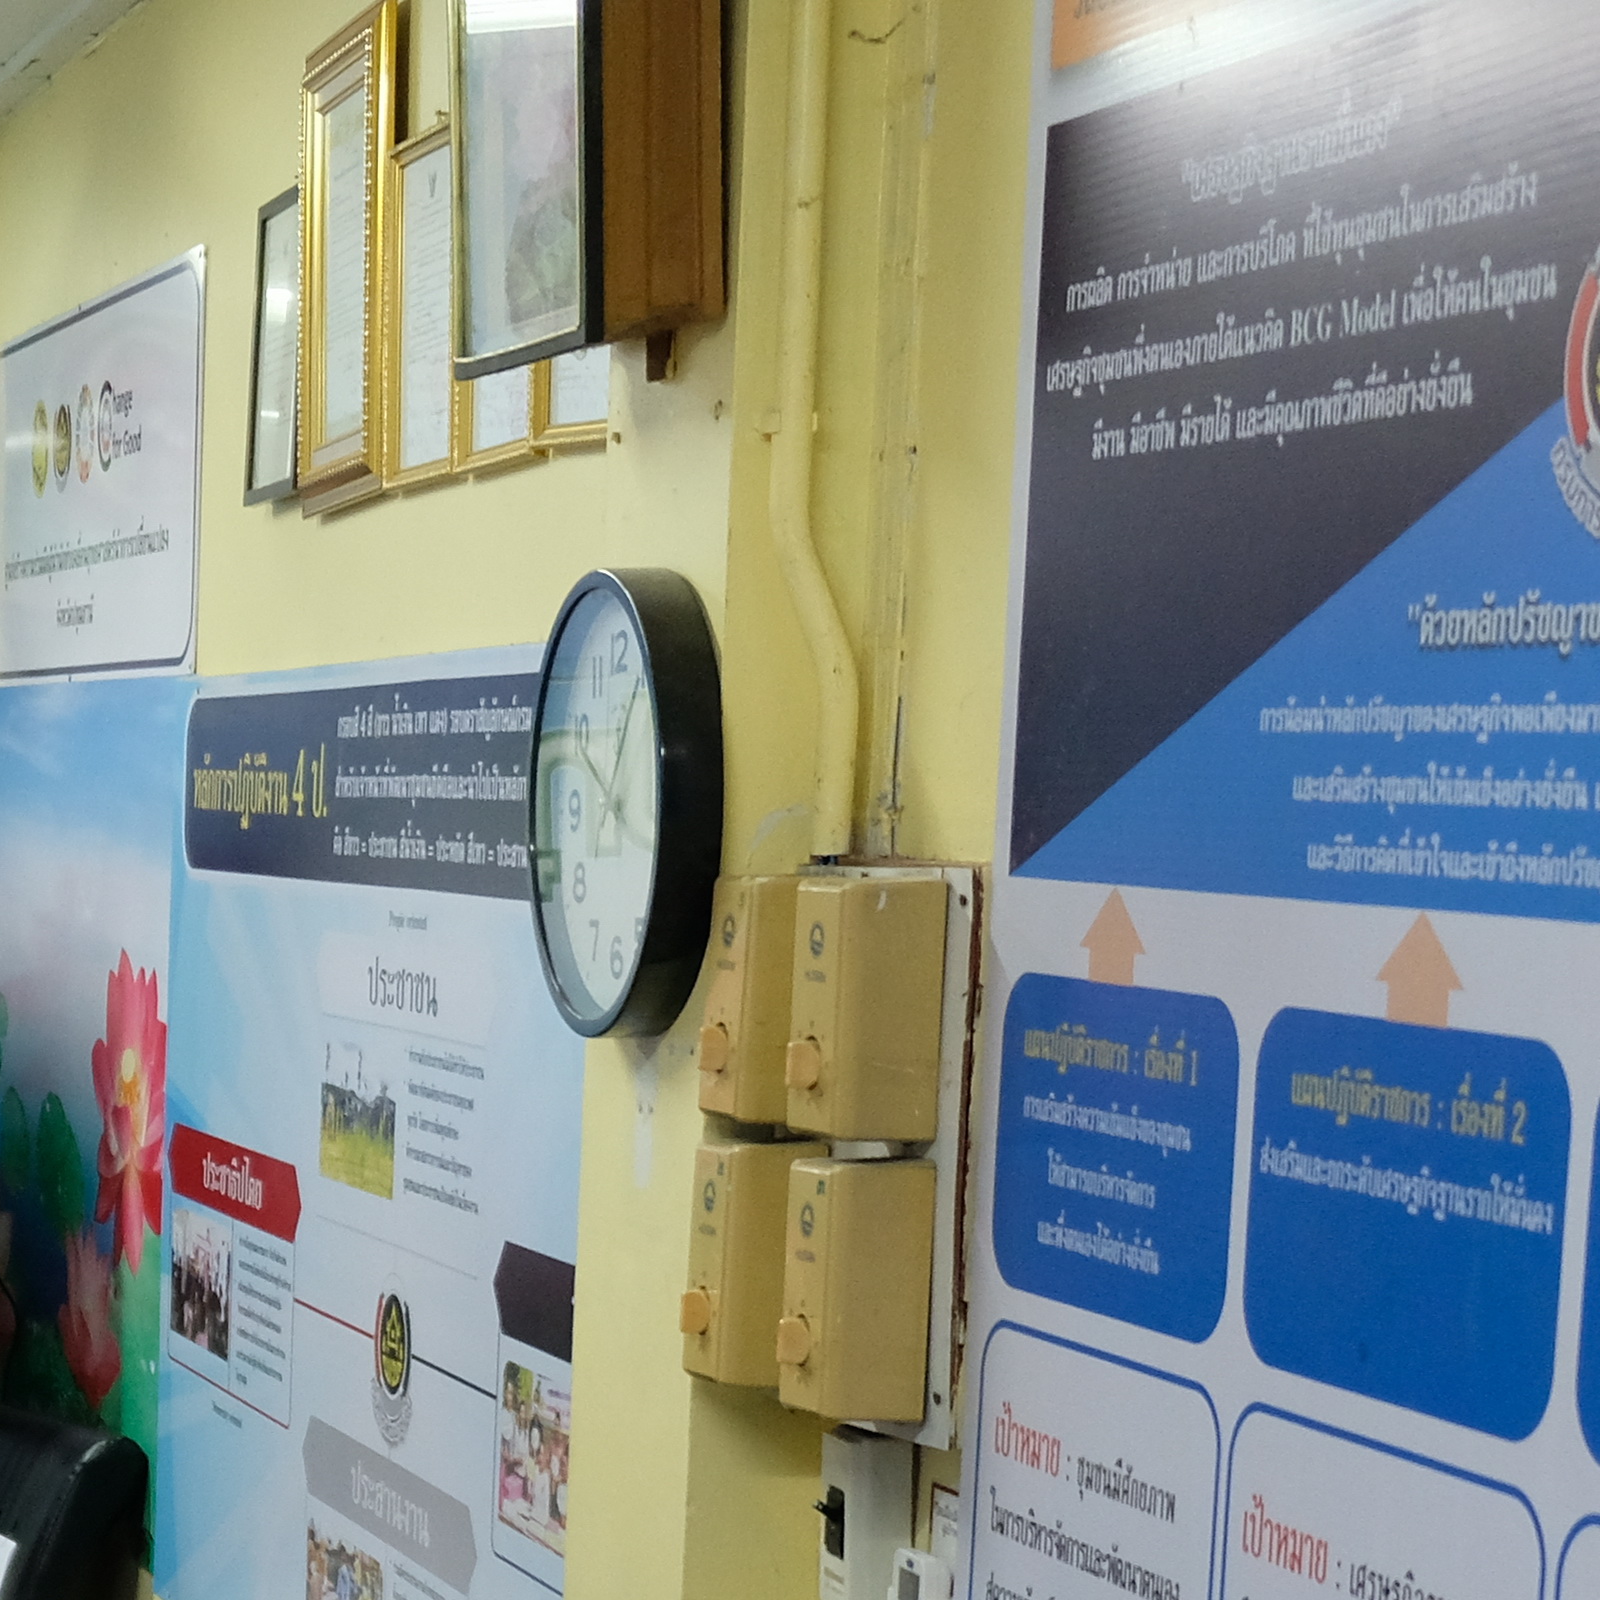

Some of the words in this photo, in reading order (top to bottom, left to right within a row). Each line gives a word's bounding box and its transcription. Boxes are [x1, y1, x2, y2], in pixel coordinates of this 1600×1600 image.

[1066, 266, 1114, 312] การผลิต
[1117, 246, 1193, 301] การจำหน่าย
[1196, 217, 1297, 285] และการบริโภค
[1288, 301, 1334, 348] BCG
[1338, 287, 1398, 337] Model
[1091, 416, 1126, 461] มีงาน
[1129, 403, 1176, 455] มีอาชีพ
[1179, 394, 1232, 448] มีรายได้
[610, 630, 629, 675] 12
[193, 751, 288, 830] หลักการปฏิบัติงาน
[292, 748, 306, 818] 4
[311, 741, 328, 818] ป.
[567, 788, 583, 834] 9
[572, 861, 588, 904] 8
[588, 919, 601, 964] 7
[608, 936, 624, 981] 6
[367, 955, 439, 1019] ประชาชน
[1510, 1100, 1528, 1147] 2
[994, 1401, 1062, 1478] เป้าหมาย
[1076, 1456, 1177, 1524] ชุมชนมีศักยภาพ
[1241, 1493, 1330, 1586] เป้าหมาย
